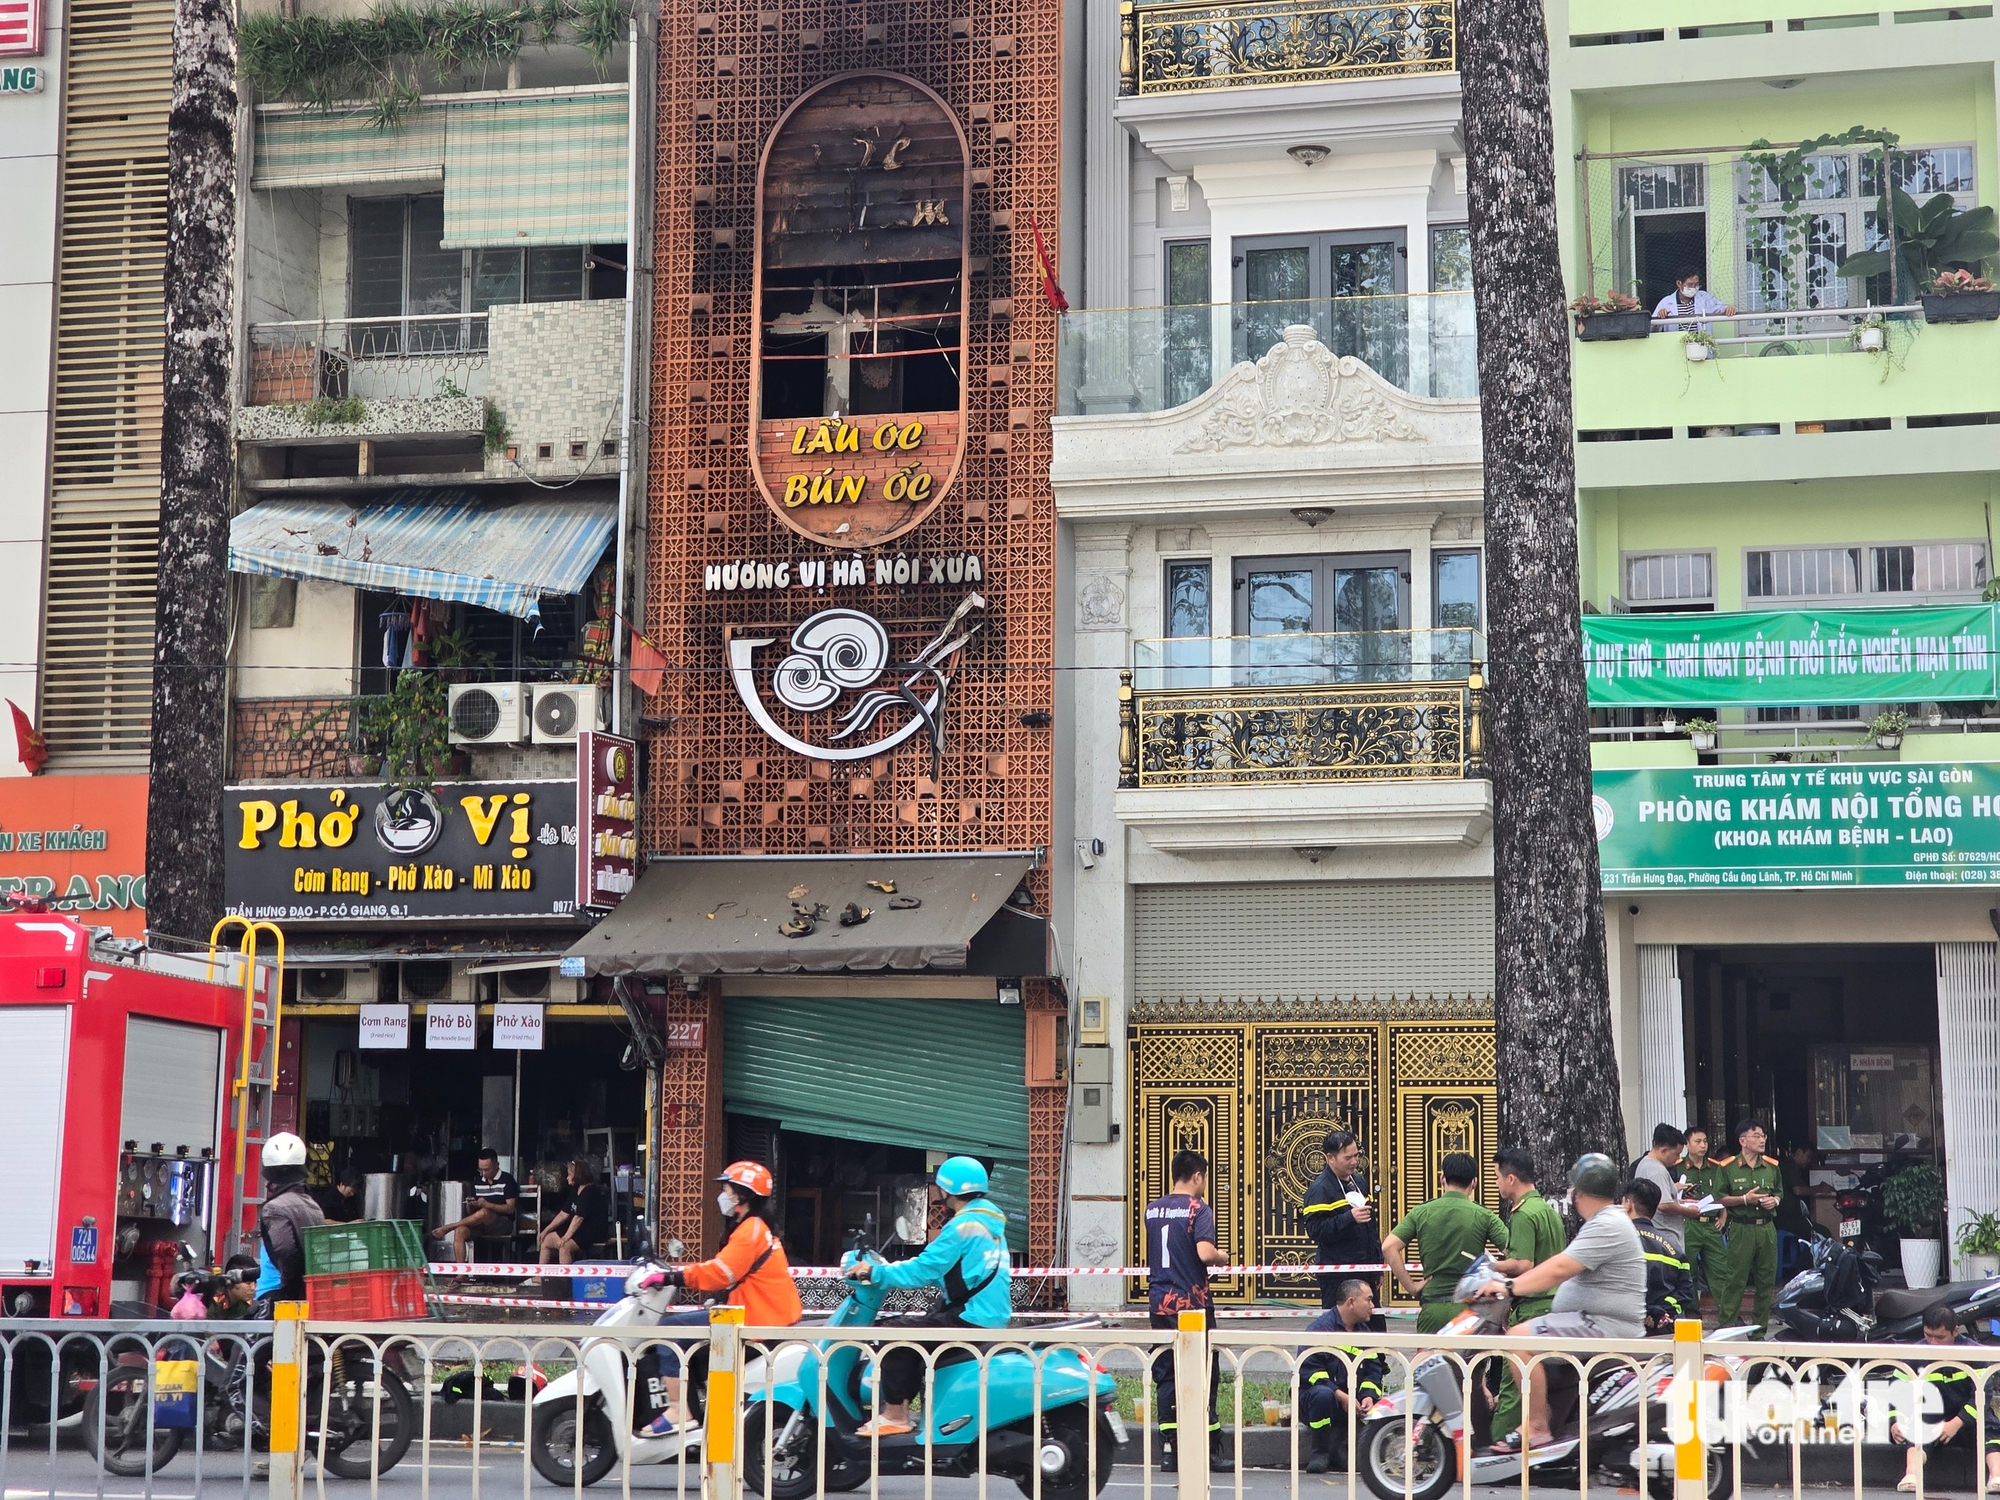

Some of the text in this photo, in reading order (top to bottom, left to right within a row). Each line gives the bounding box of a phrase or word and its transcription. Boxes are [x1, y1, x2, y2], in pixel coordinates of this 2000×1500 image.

[0, 66, 37, 91] NG
[784, 460, 933, 508] BÚN ỐC
[705, 552, 982, 594] HƯƠNG VỊ HÀ NỘI XƯA
[1595, 643, 1624, 686] HỤT
[1628, 638, 1653, 678] HƠI
[1666, 633, 1700, 678] NGHĨ
[1703, 642, 1741, 677] NGAY
[1745, 631, 1785, 684] BỆNH
[1789, 620, 1825, 676] PHỔI
[1828, 623, 1857, 674] TẮC
[1861, 628, 1912, 674] NGHẼN
[1915, 636, 1949, 680] MẠN
[1952, 626, 1988, 671] TÍNH
[1693, 767, 1973, 788] TRUNG TÂM Y TẾ KHU VỰC SÀI GÒN
[1638, 795, 1731, 823] PHÒNG
[1741, 793, 1821, 821] KHÁM
[1831, 792, 1879, 824] NỘI
[1887, 787, 1962, 819] TỔNG
[238, 789, 360, 849] Phở
[460, 792, 531, 859] Vị
[17, 831, 42, 852] XE
[45, 823, 106, 851] KHÁCH
[1714, 830, 1772, 850] (KHOA
[1777, 826, 1832, 846] KHÁM
[1838, 826, 1890, 848] BỆNH
[1910, 827, 1953, 847] LAO)
[1913, 852, 1939, 862] GPHĐ
[294, 867, 326, 893] Cơm
[331, 867, 369, 896] Rang
[388, 863, 418, 891] Phở
[423, 864, 454, 891] Xào
[473, 864, 494, 890] Mì
[500, 864, 531, 890] Xào
[1603, 873, 1619, 884] 231
[1621, 871, 1641, 884] Trần
[1643, 872, 1665, 885] Hưng
[1667, 872, 1686, 886] Đạo,
[1689, 872, 1719, 885] Phường
[1722, 870, 1738, 883] Cầu
[1741, 872, 1757, 885] ông
[1759, 871, 1782, 883] Lãnh,
[1784, 871, 1799, 882] TP.
[1801, 870, 1813, 881] Hồ
[1815, 870, 1829, 881] Chí
[1831, 870, 1853, 881] Minh
[1905, 869, 1927, 882] Điện
[1930, 869, 1958, 882] thoại:
[1961, 869, 1987, 881] (028)
[225, 901, 253, 917] TRẦN
[255, 904, 287, 917] HƯNG
[390, 904, 408, 917] Q.1
[553, 901, 574, 913] 0977
[384, 1016, 407, 1028] Rang
[429, 1014, 472, 1029] Phở Bò
[496, 1014, 541, 1028] Phở Xào
[668, 1023, 702, 1041] 227
[77, 1228, 92, 1245] 72A
[1161, 1224, 1170, 1269] 1
